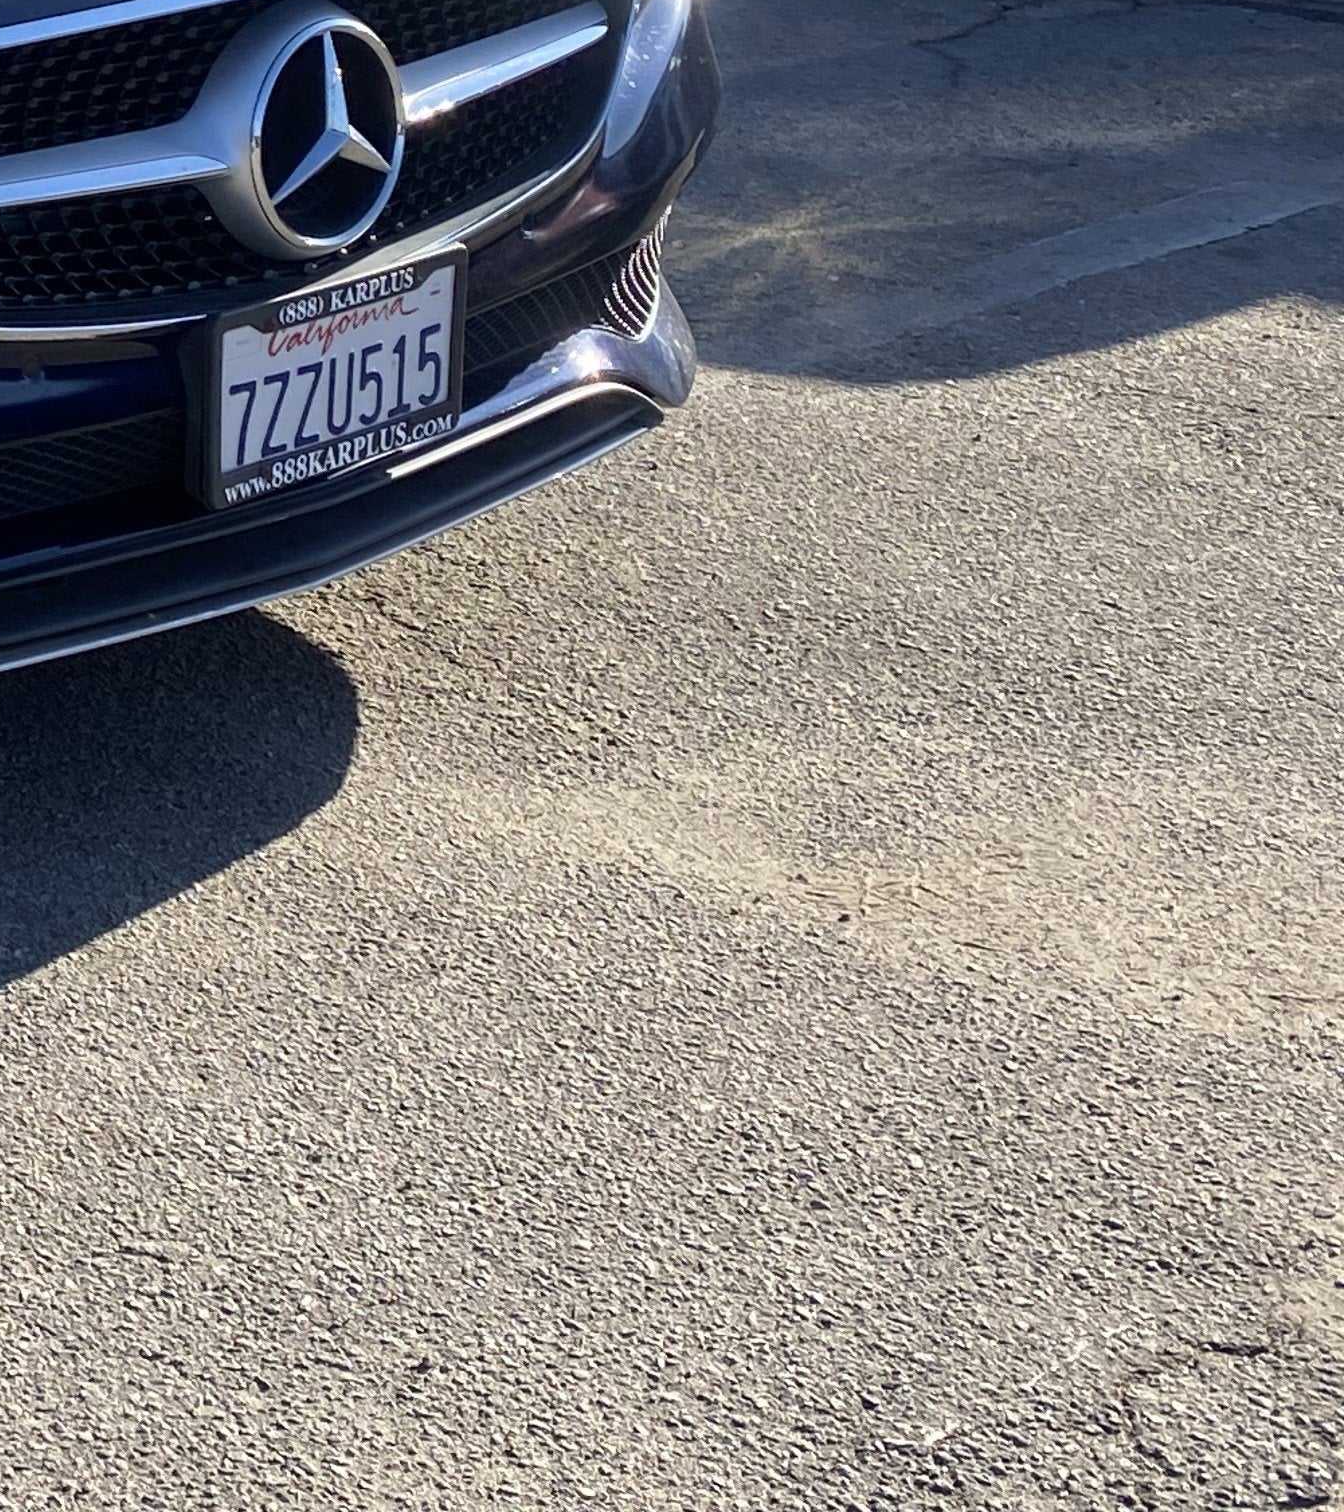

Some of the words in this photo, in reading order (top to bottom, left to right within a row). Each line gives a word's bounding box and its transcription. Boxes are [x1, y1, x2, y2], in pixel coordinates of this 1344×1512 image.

[267, 295, 419, 356] California
[279, 297, 324, 325] (888)
[329, 267, 414, 311] KARPLUS
[229, 323, 441, 466] 7ZZU515
